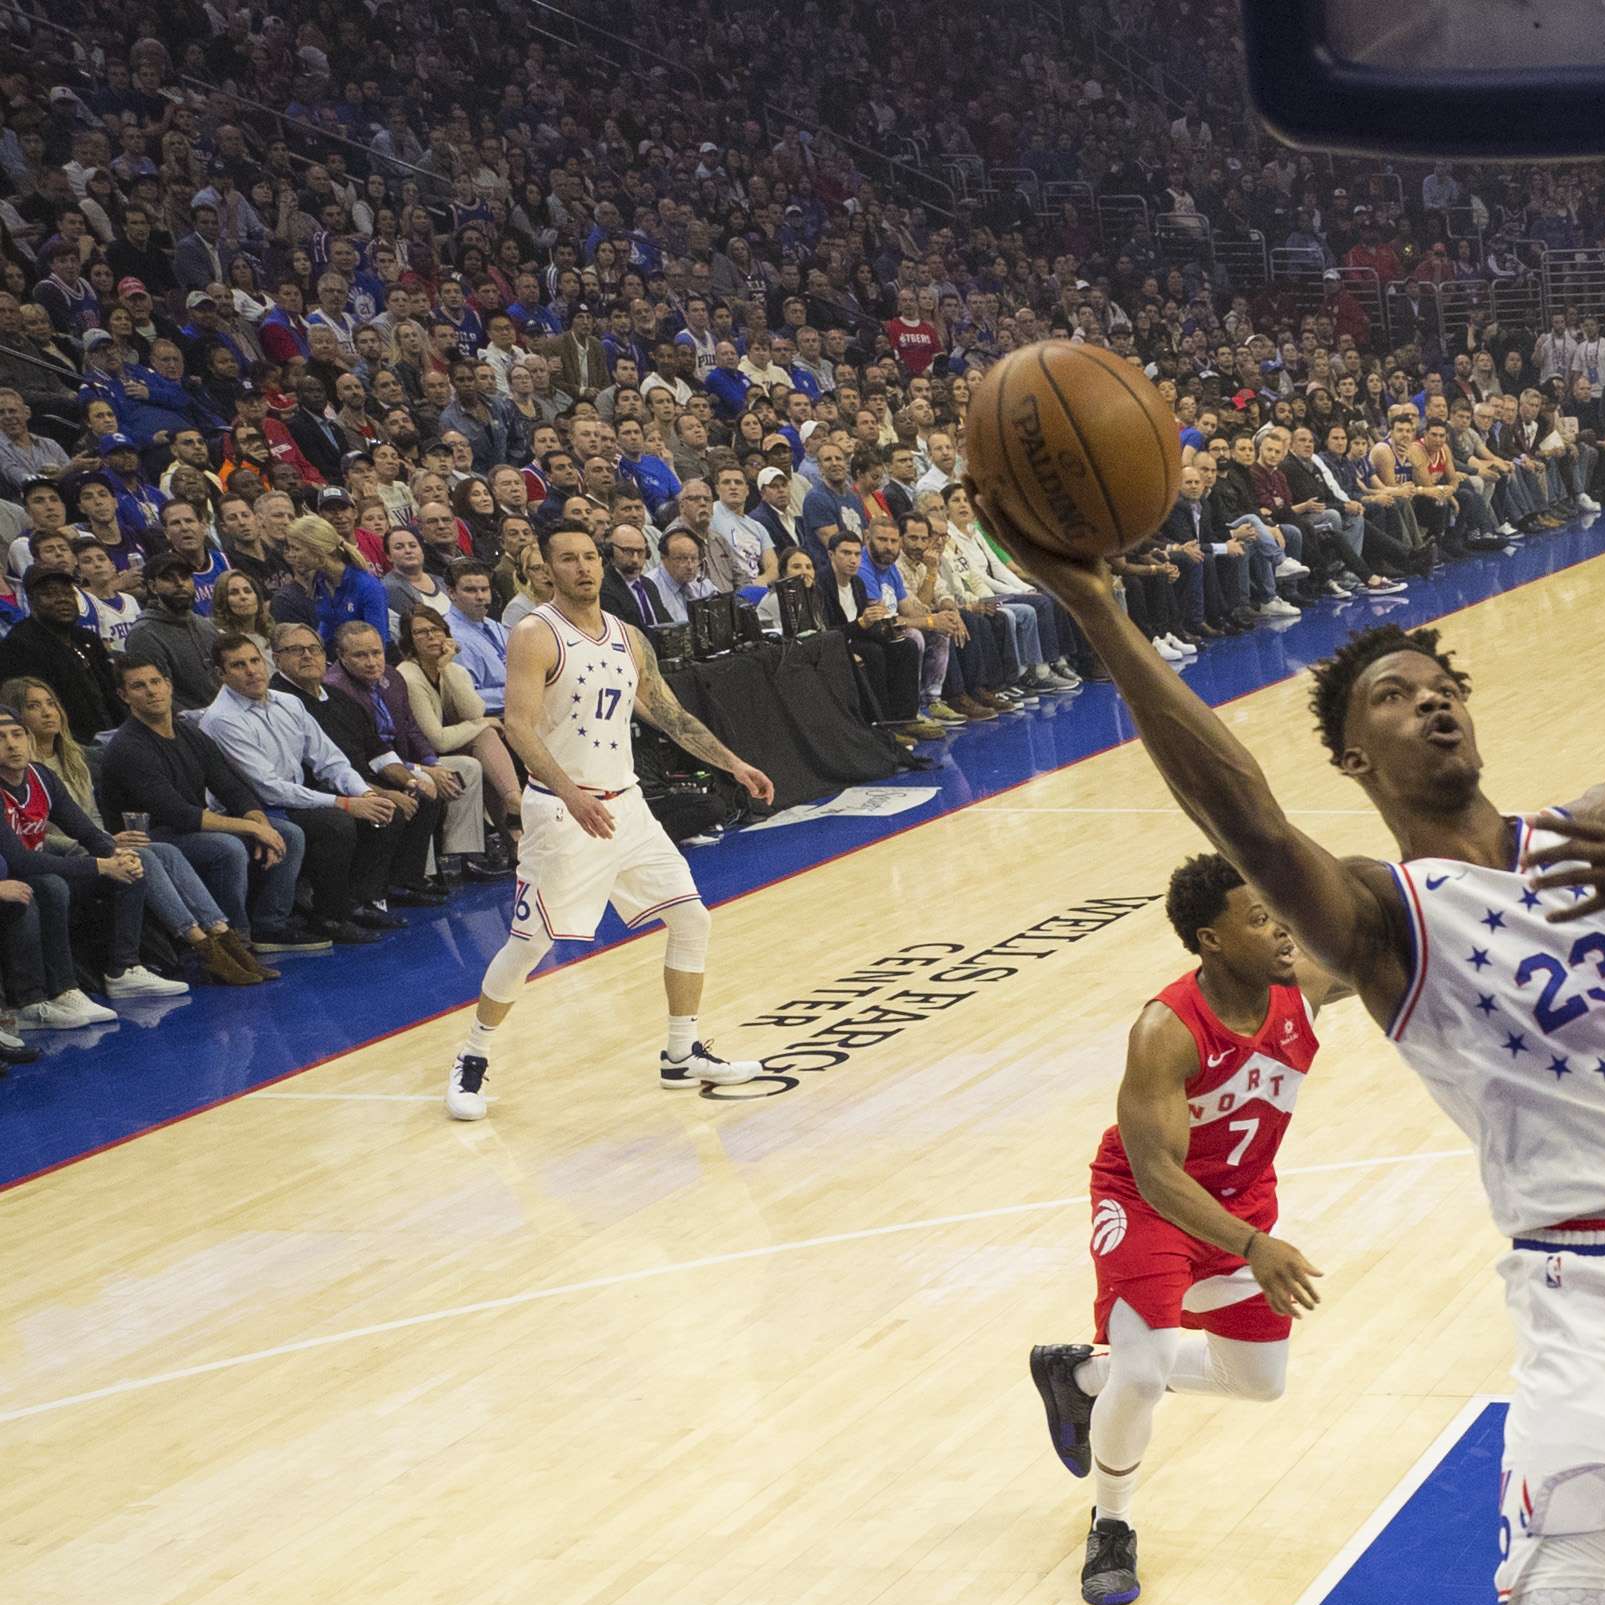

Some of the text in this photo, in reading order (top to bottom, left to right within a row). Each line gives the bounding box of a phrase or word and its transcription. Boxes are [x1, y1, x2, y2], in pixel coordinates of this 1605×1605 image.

[595, 688, 622, 720] 17
[928, 893, 1166, 984] WELLS
[739, 942, 966, 1028] CENTER
[1226, 1117, 1260, 1167] 7
